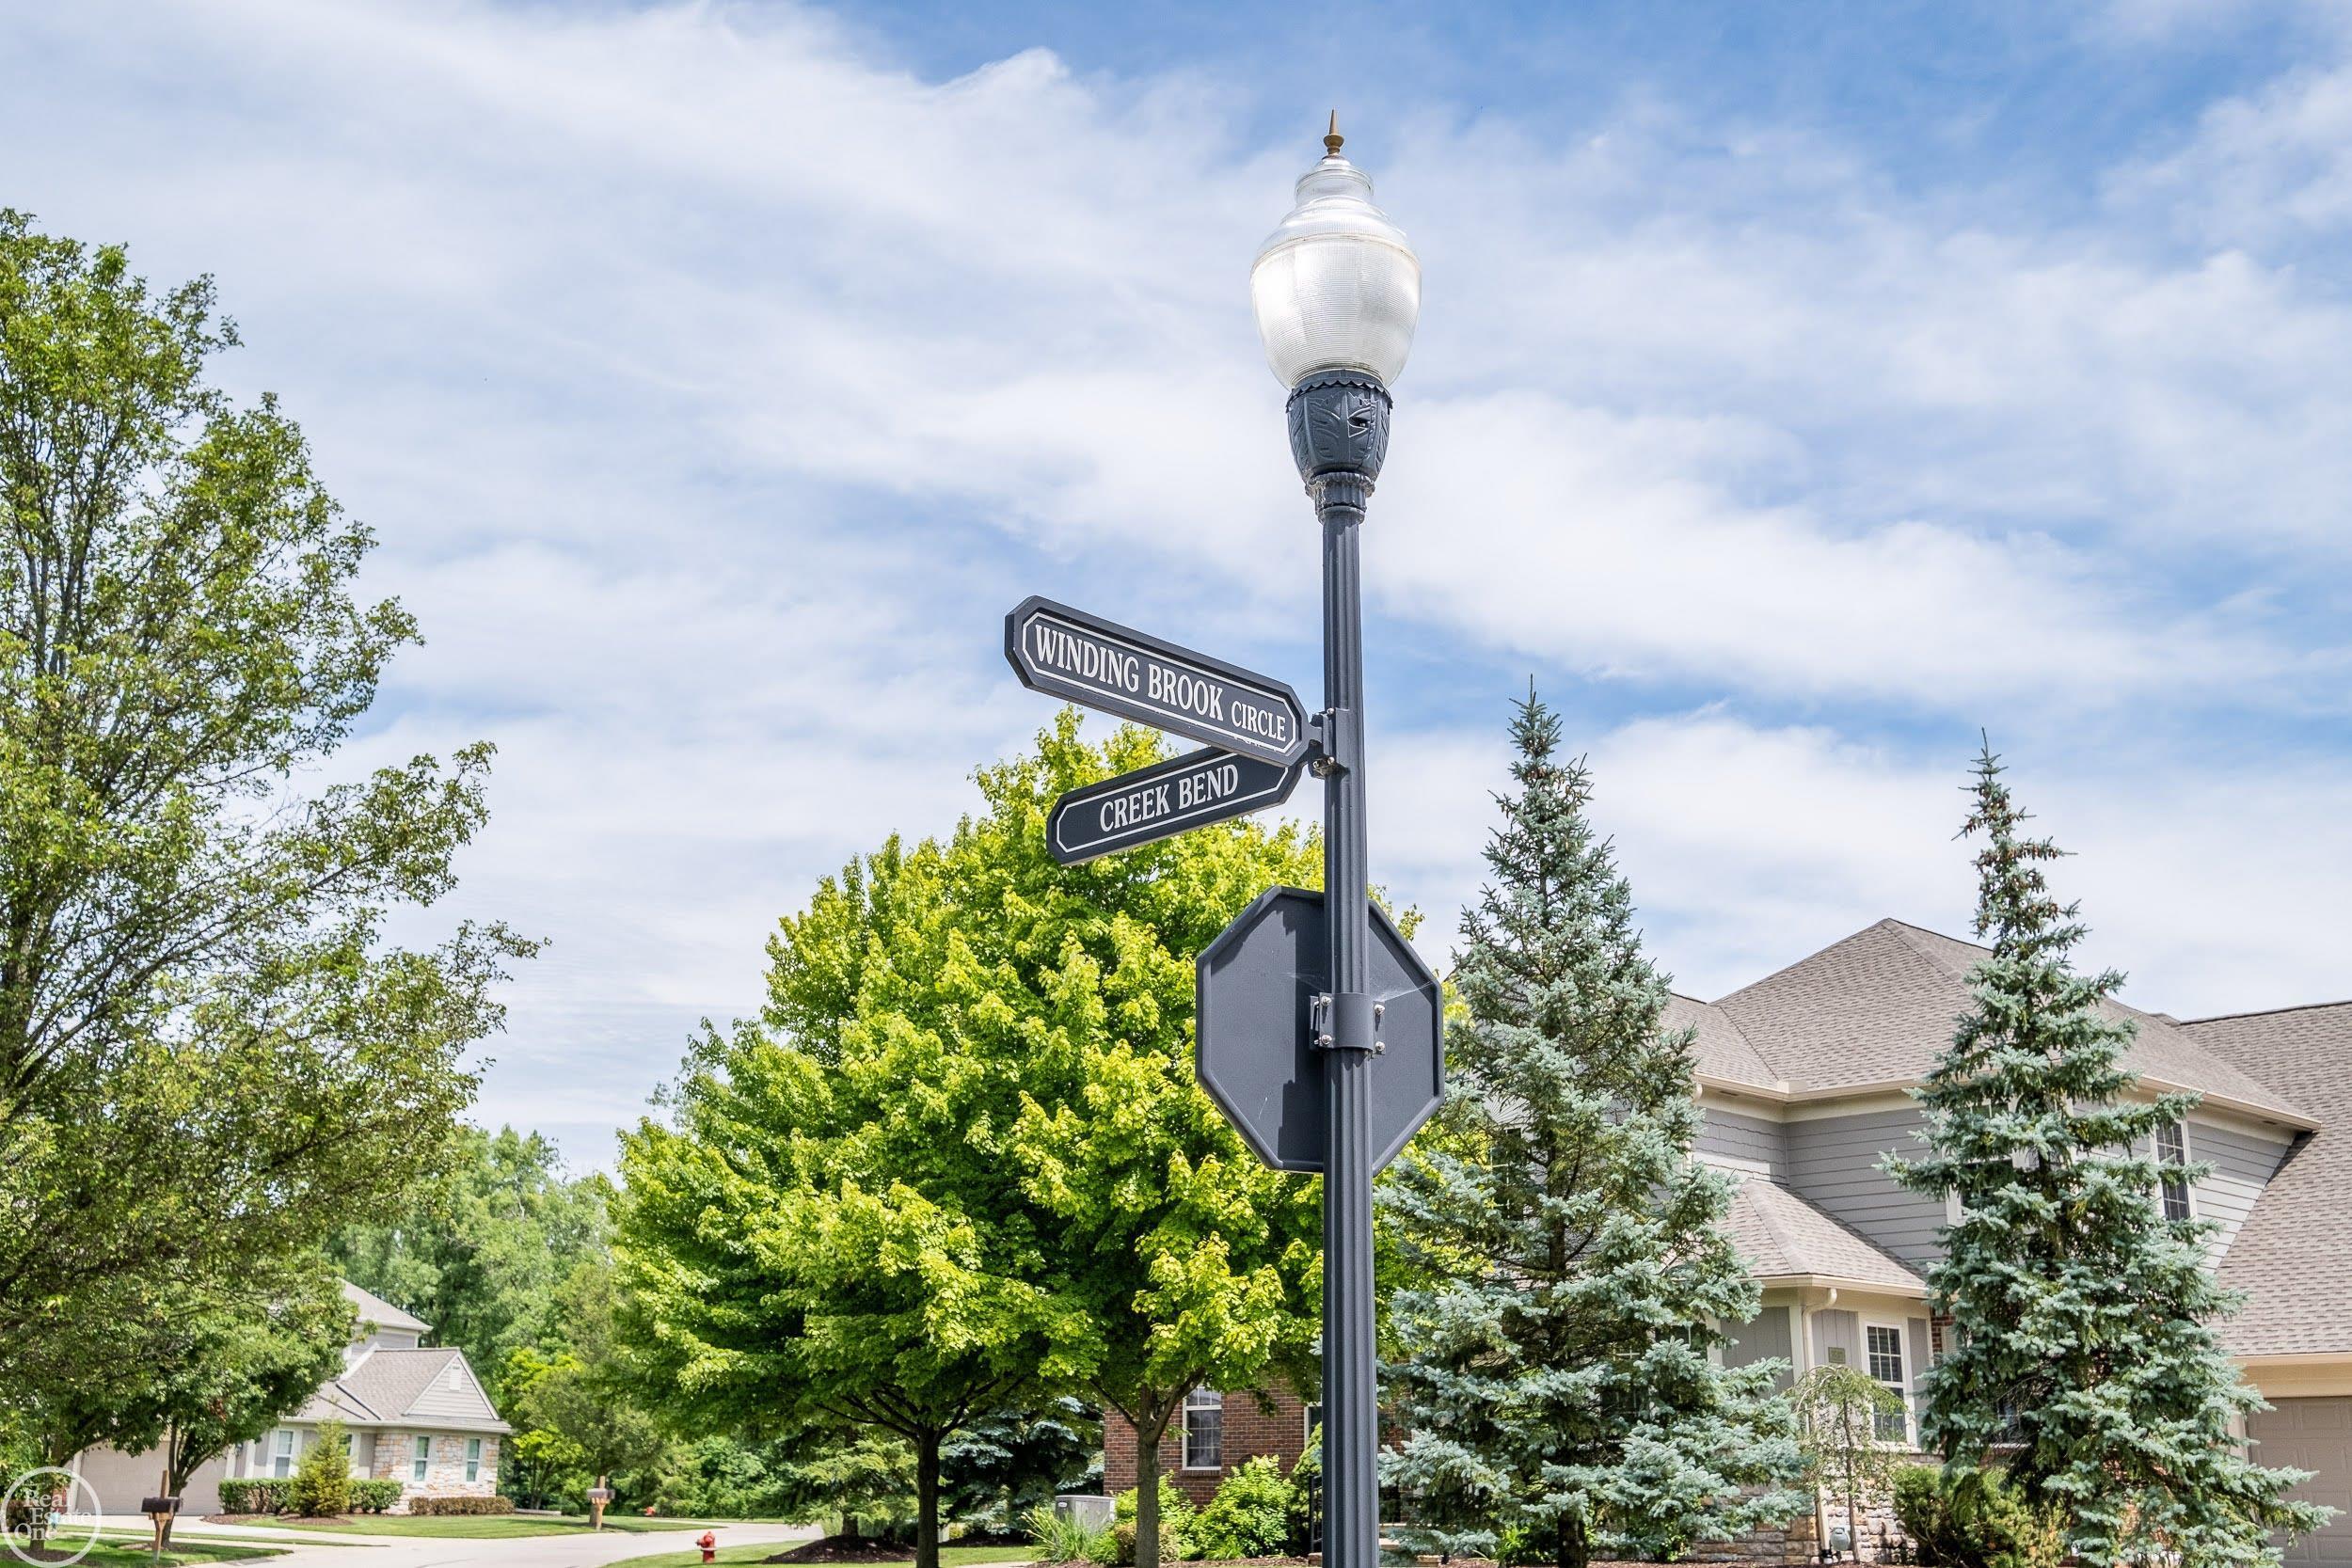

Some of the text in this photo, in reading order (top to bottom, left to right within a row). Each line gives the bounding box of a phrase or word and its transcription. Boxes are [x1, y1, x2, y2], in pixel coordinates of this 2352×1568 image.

[1035, 625, 1286, 741] WINDING BROOK CIRCLE
[1100, 764, 1239, 832] CREEK BEND
